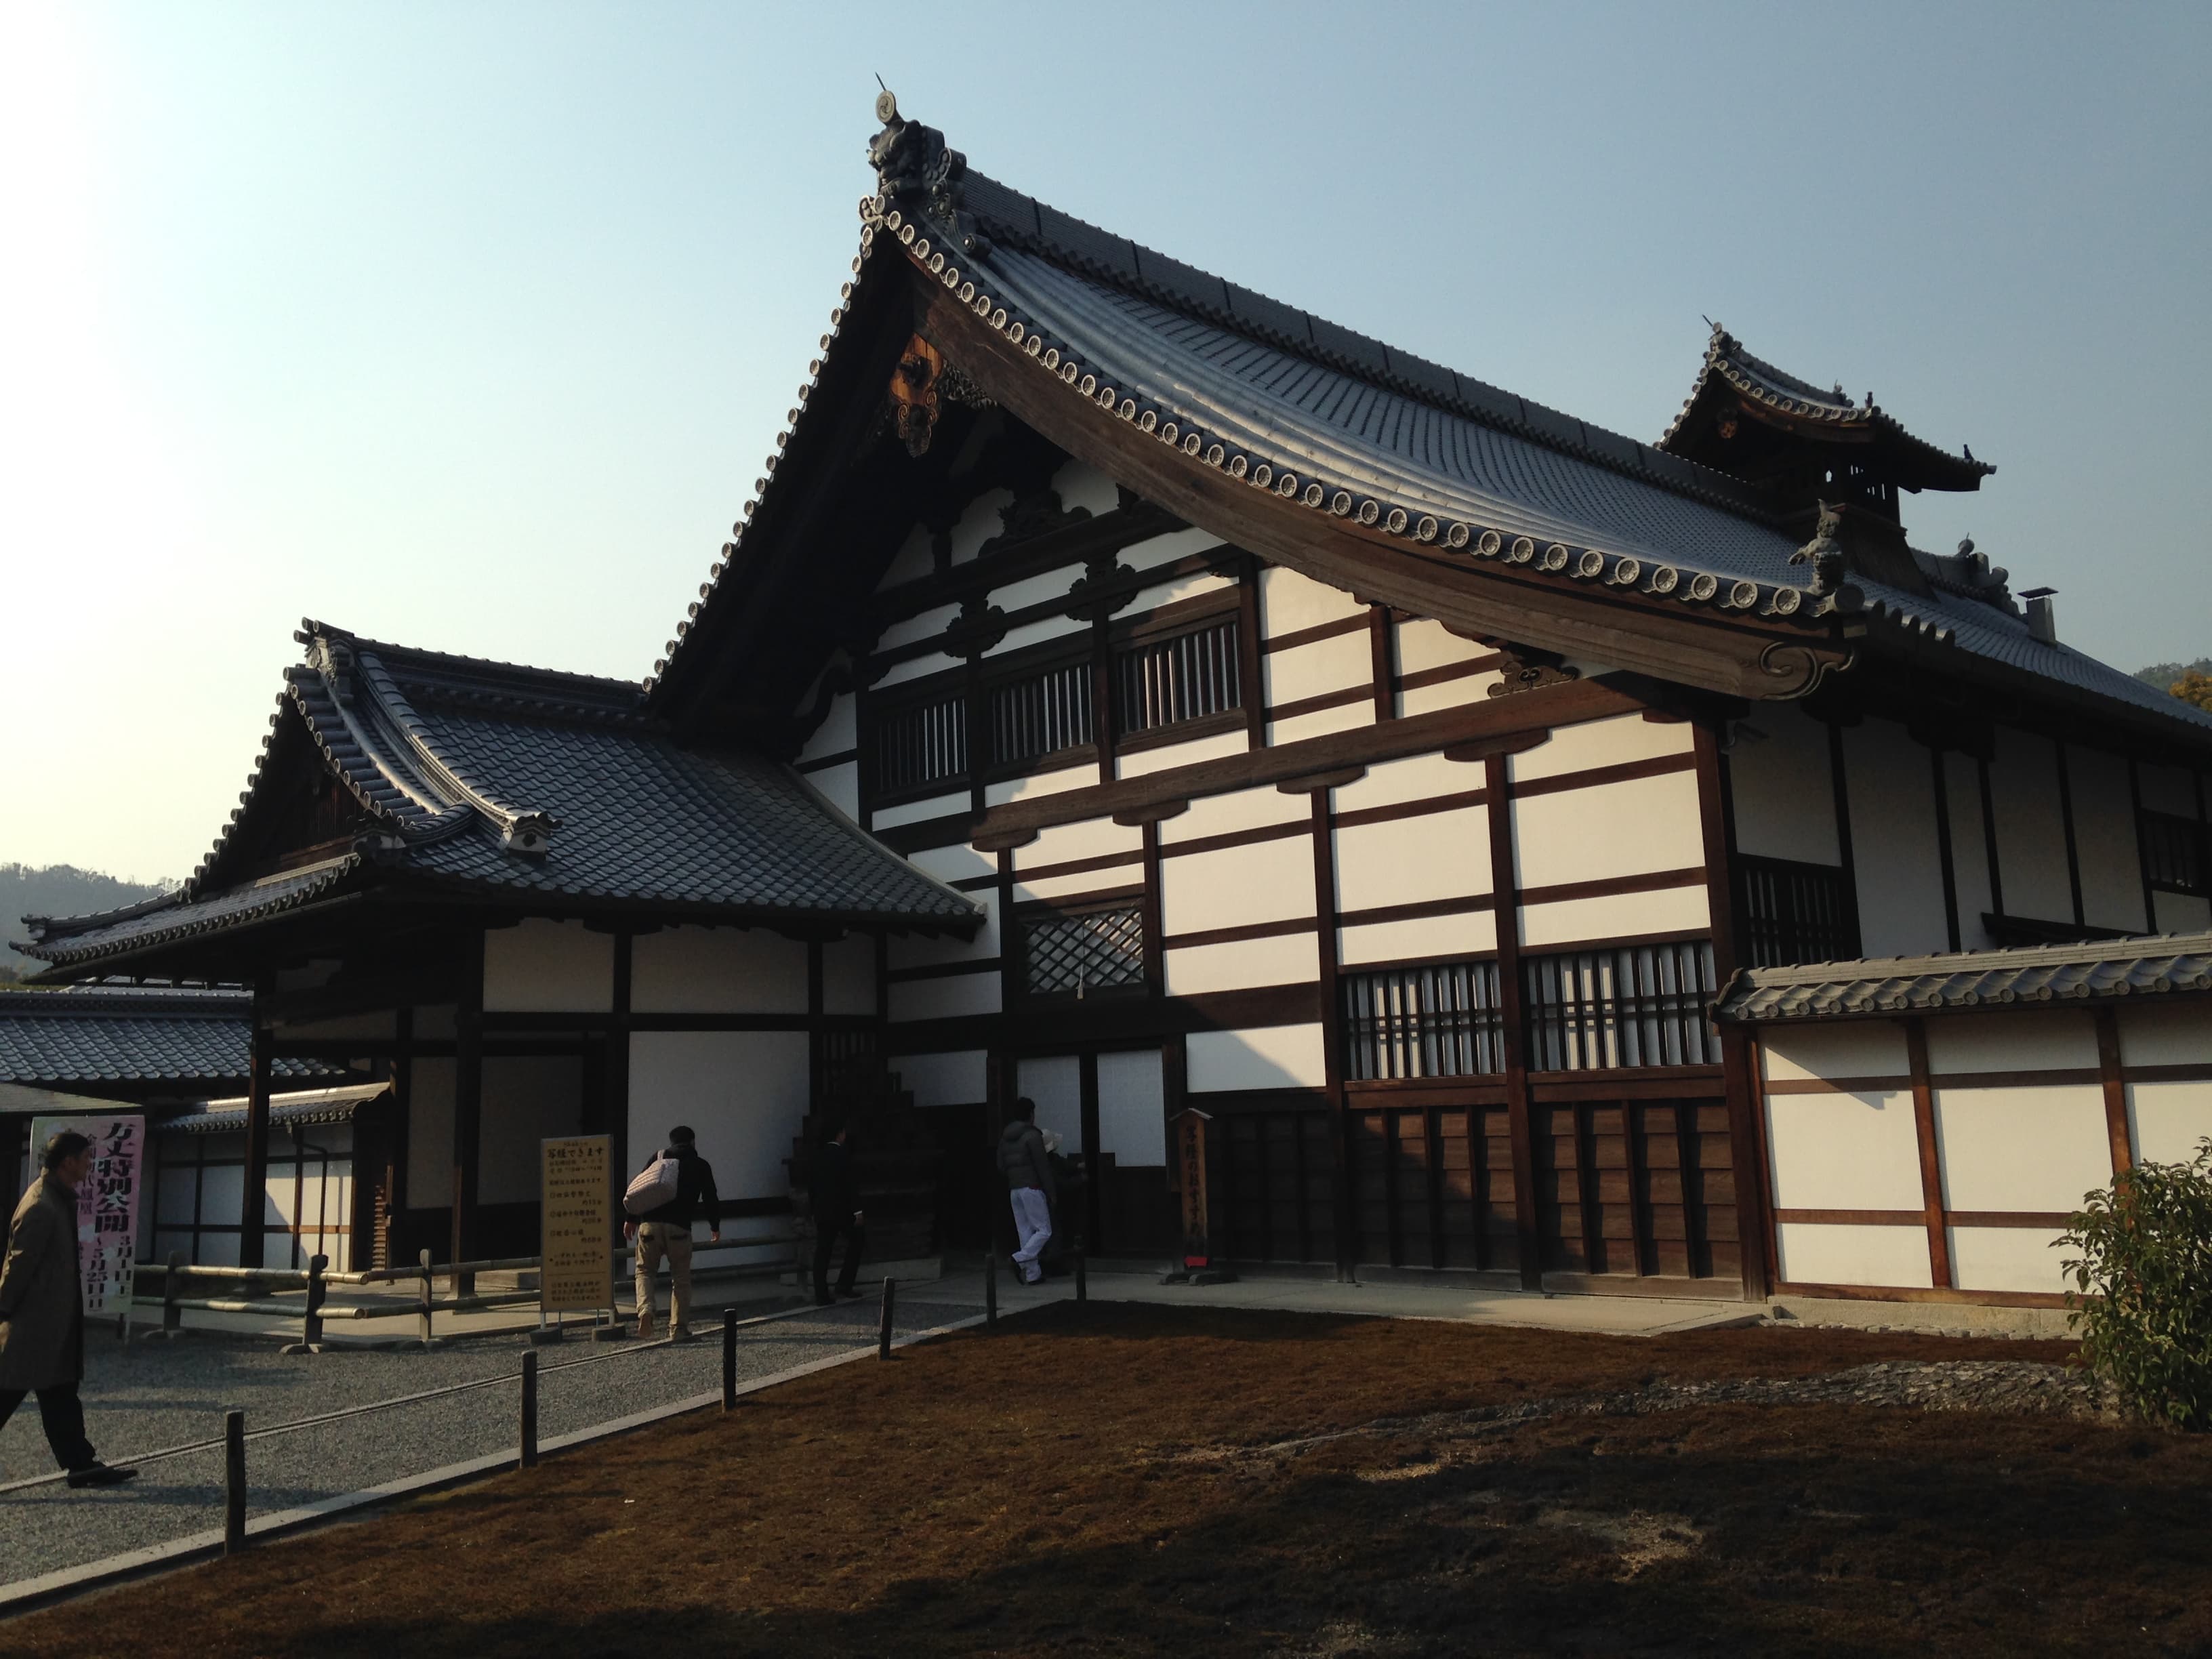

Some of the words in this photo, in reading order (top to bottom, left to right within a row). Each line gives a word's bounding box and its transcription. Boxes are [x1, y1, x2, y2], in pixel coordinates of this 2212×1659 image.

[95, 1122, 136, 1233] 方丈特別公開
